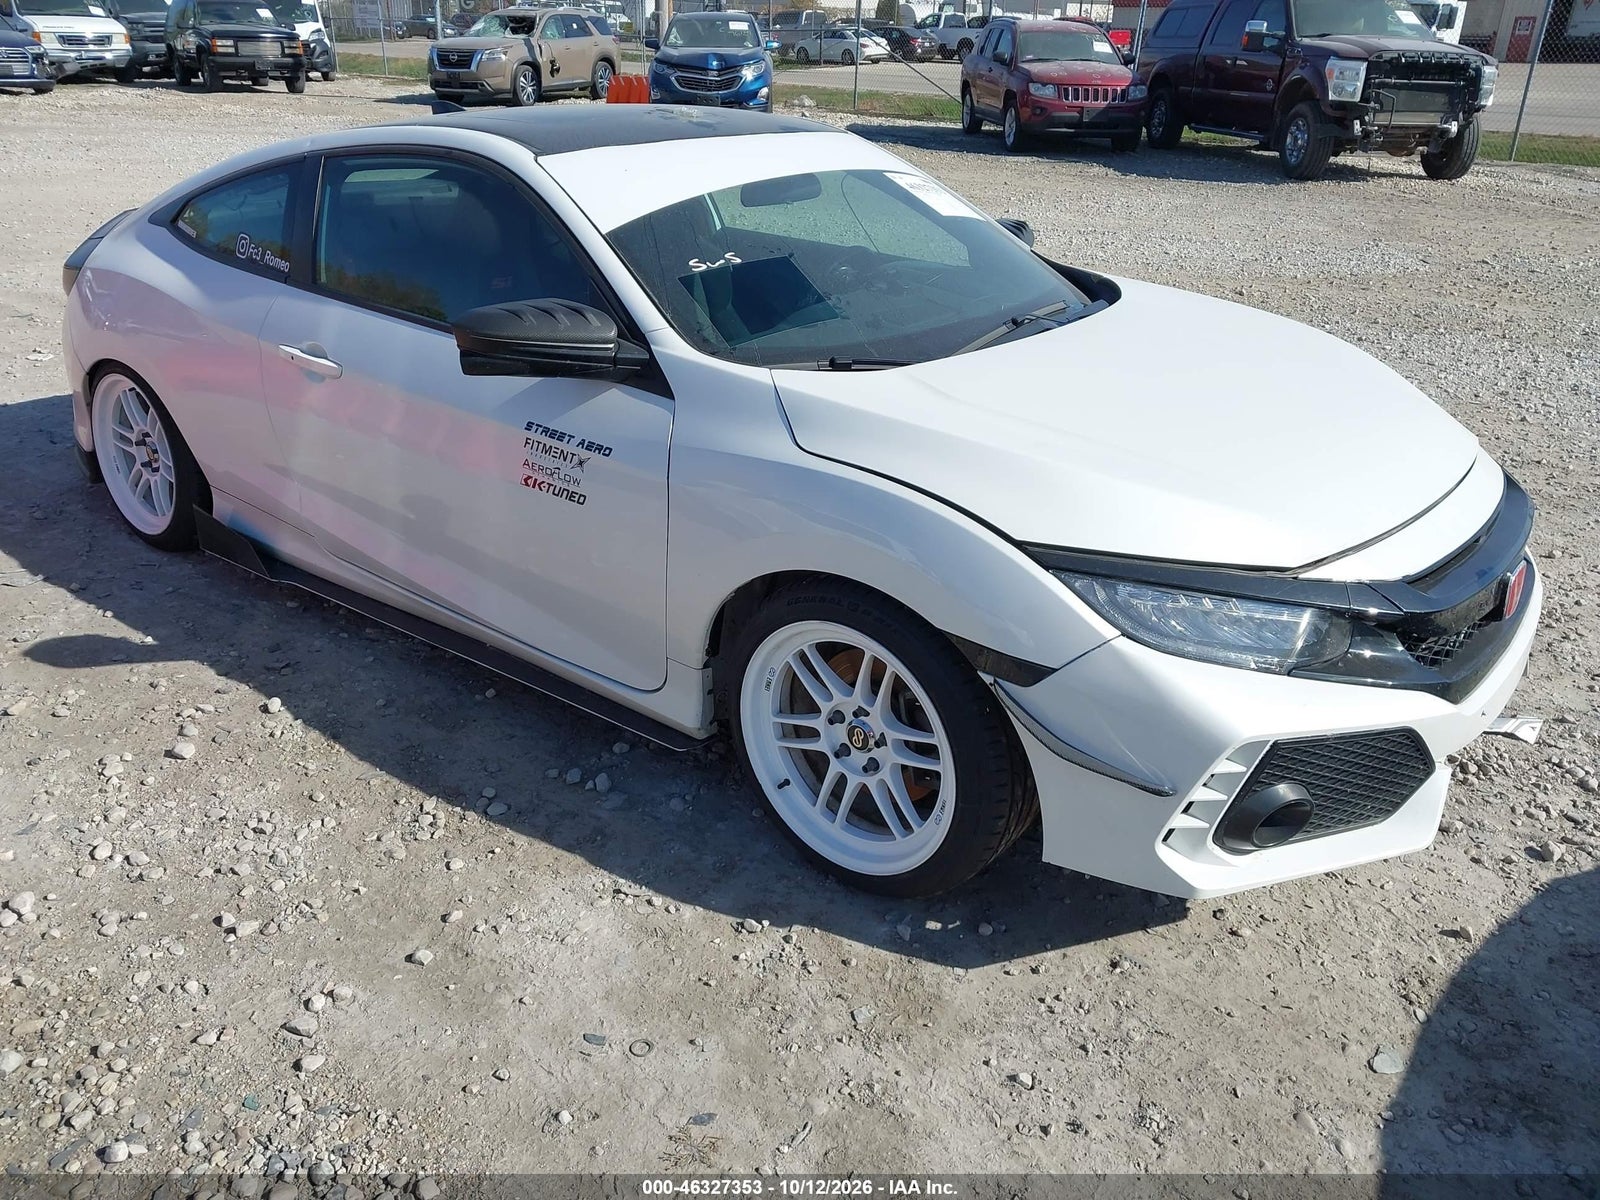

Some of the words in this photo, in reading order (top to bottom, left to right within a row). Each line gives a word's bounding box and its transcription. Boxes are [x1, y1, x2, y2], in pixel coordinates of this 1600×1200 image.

[248, 243, 290, 273] Fc3_Romeo
[524, 421, 575, 444] STREET
[576, 438, 613, 457] AERO
[522, 458, 581, 487] AEROFLOW
